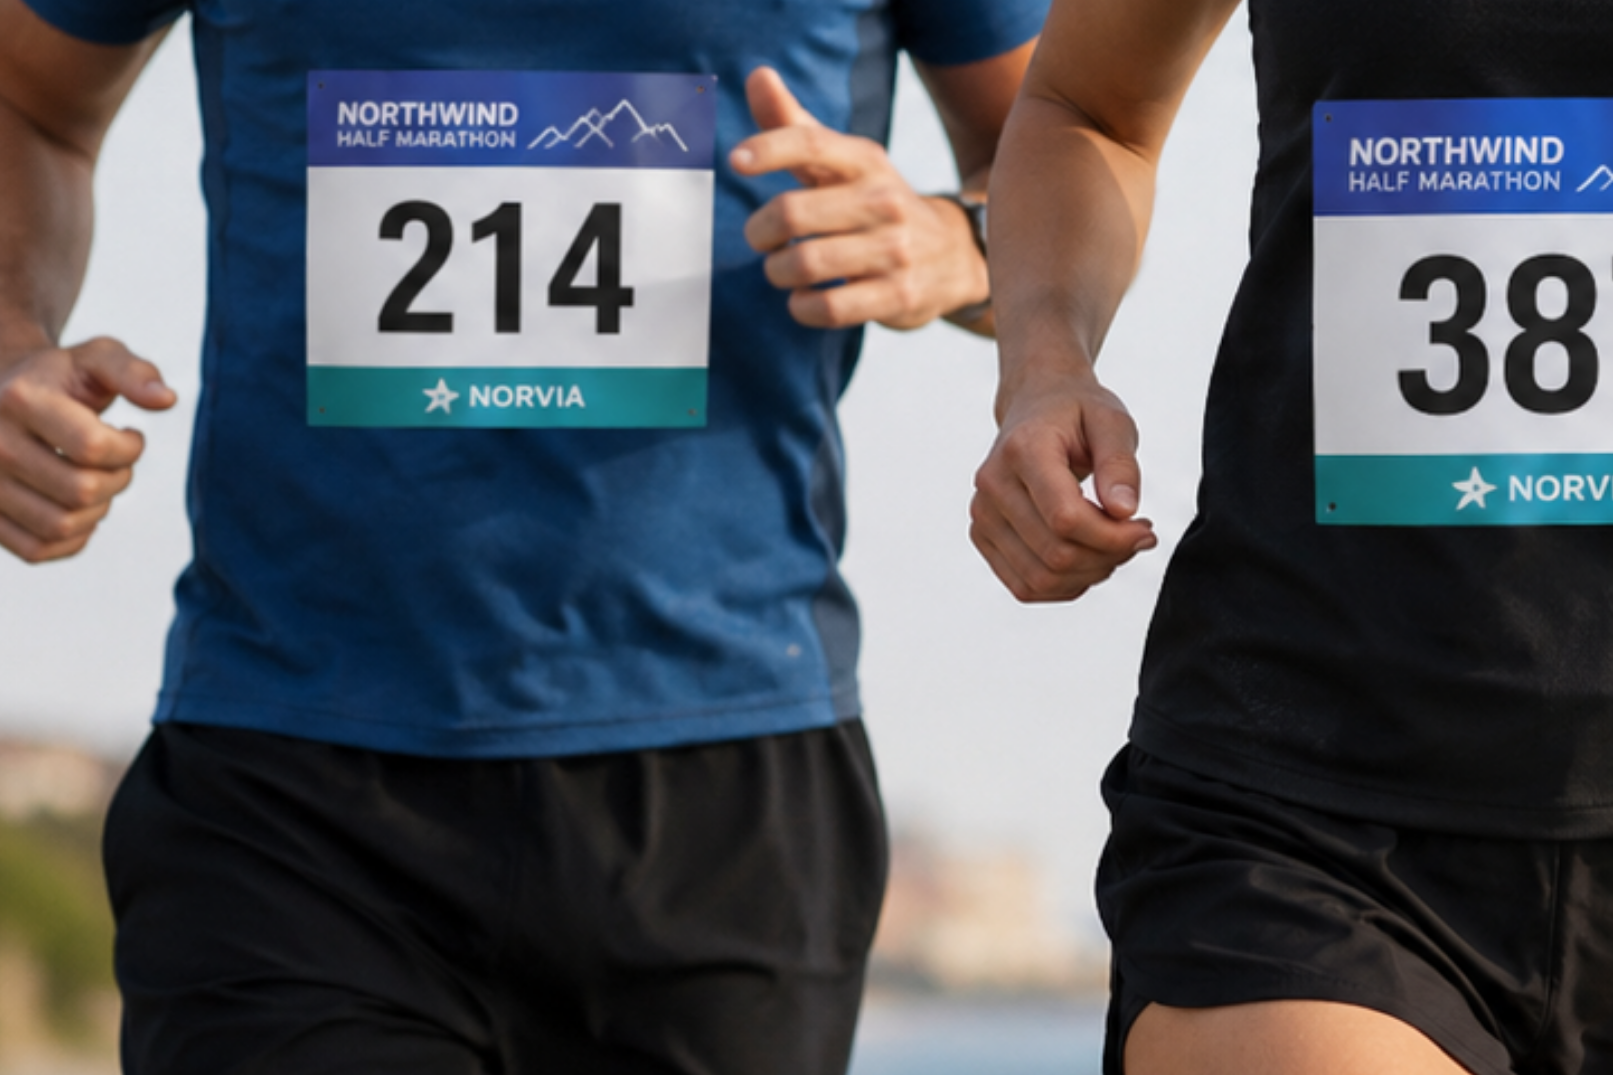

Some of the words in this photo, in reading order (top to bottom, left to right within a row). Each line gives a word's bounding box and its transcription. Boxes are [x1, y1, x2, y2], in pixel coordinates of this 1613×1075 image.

[337, 101, 519, 126] NORTHWIND
[337, 130, 390, 148] HALF
[395, 130, 516, 148] MARATHON
[1349, 136, 1565, 166] NORTHWIND
[1349, 171, 1410, 192] HALF
[1418, 171, 1561, 192] MARATHON
[377, 199, 635, 335] 214
[469, 384, 586, 408] NORVIA
